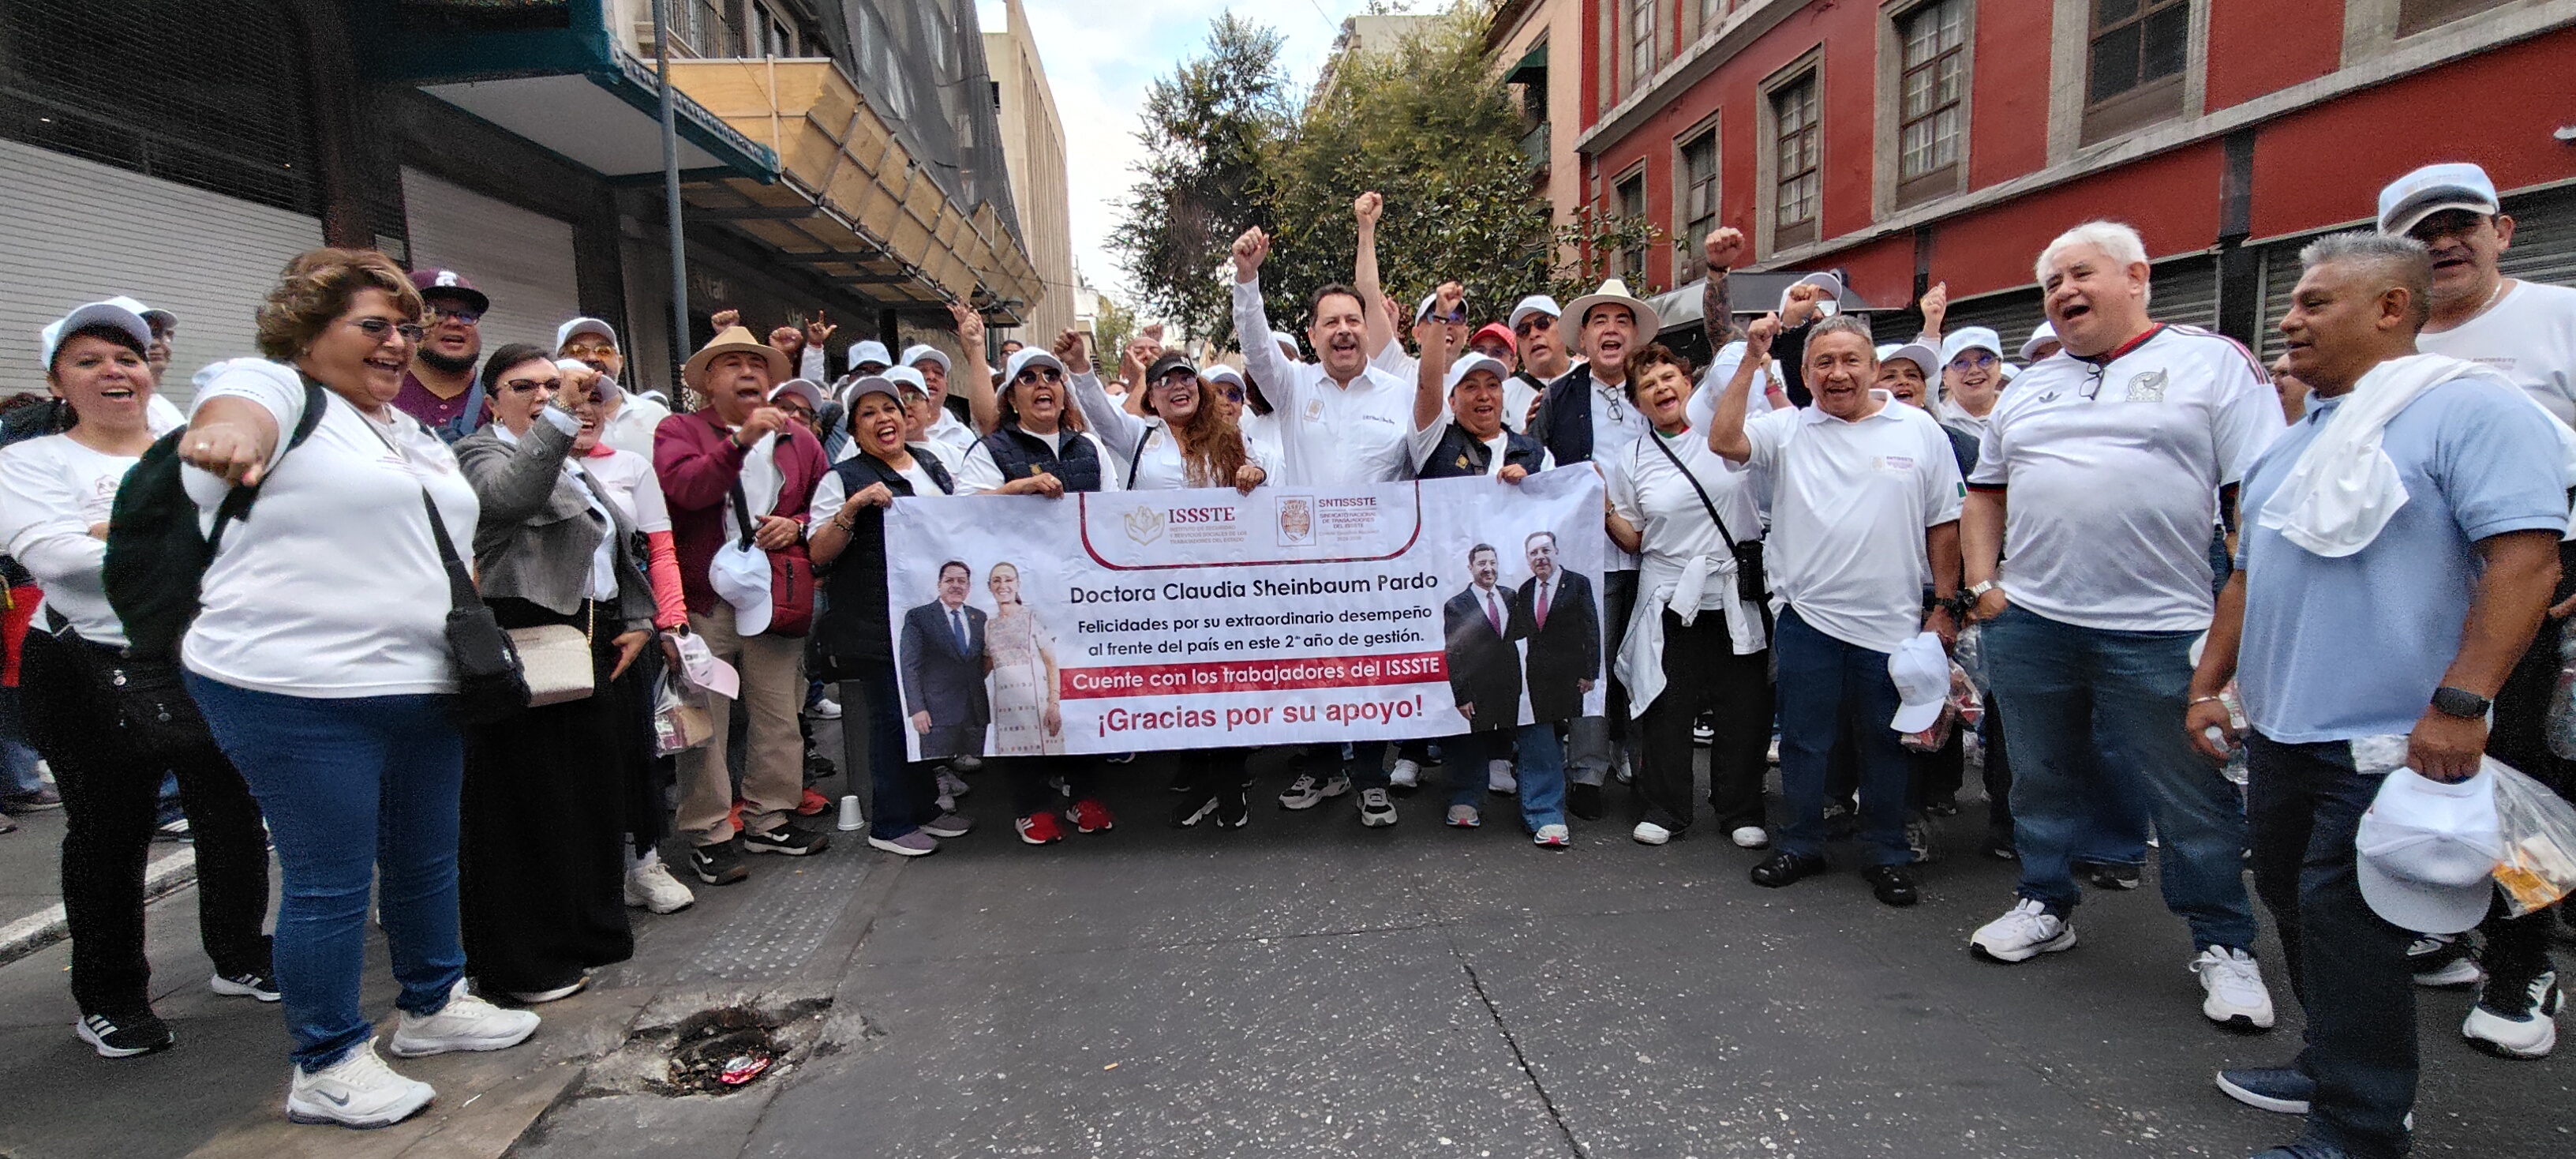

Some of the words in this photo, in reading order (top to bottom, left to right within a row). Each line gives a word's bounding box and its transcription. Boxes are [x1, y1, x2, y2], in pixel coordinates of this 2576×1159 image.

[1168, 506, 1235, 523] ISSSTE
[1319, 497, 1376, 508] SNTISSSTE
[1070, 586, 1156, 604] Doctora
[1163, 580, 1246, 601] Claudia
[1252, 577, 1371, 597] Sheinbaum
[1378, 572, 1438, 591] Pardo
[1078, 618, 1169, 633] Felicidades
[1174, 618, 1200, 632] por
[1204, 617, 1220, 628] su
[1225, 610, 1334, 628] extraordinario
[1339, 606, 1432, 623] desempeño
[1088, 643, 1103, 657] al
[1107, 641, 1153, 656] frente
[1158, 640, 1183, 654] del
[1187, 636, 1219, 655] país
[1224, 640, 1244, 650] en
[1249, 636, 1281, 650] este
[1303, 633, 1334, 647] año
[1339, 632, 1359, 646] de
[1364, 628, 1425, 647] gestión.
[1073, 671, 1144, 690] Cuente
[1149, 672, 1186, 687] con
[1192, 668, 1218, 685] los
[1222, 663, 1345, 685] trabajadores
[1350, 660, 1380, 678] del
[1385, 657, 1440, 676] ISSSTE
[1098, 705, 1217, 738] ¡Gracias
[1226, 706, 1274, 732] por
[1282, 704, 1316, 723] su
[1325, 694, 1423, 726] apoyo!
